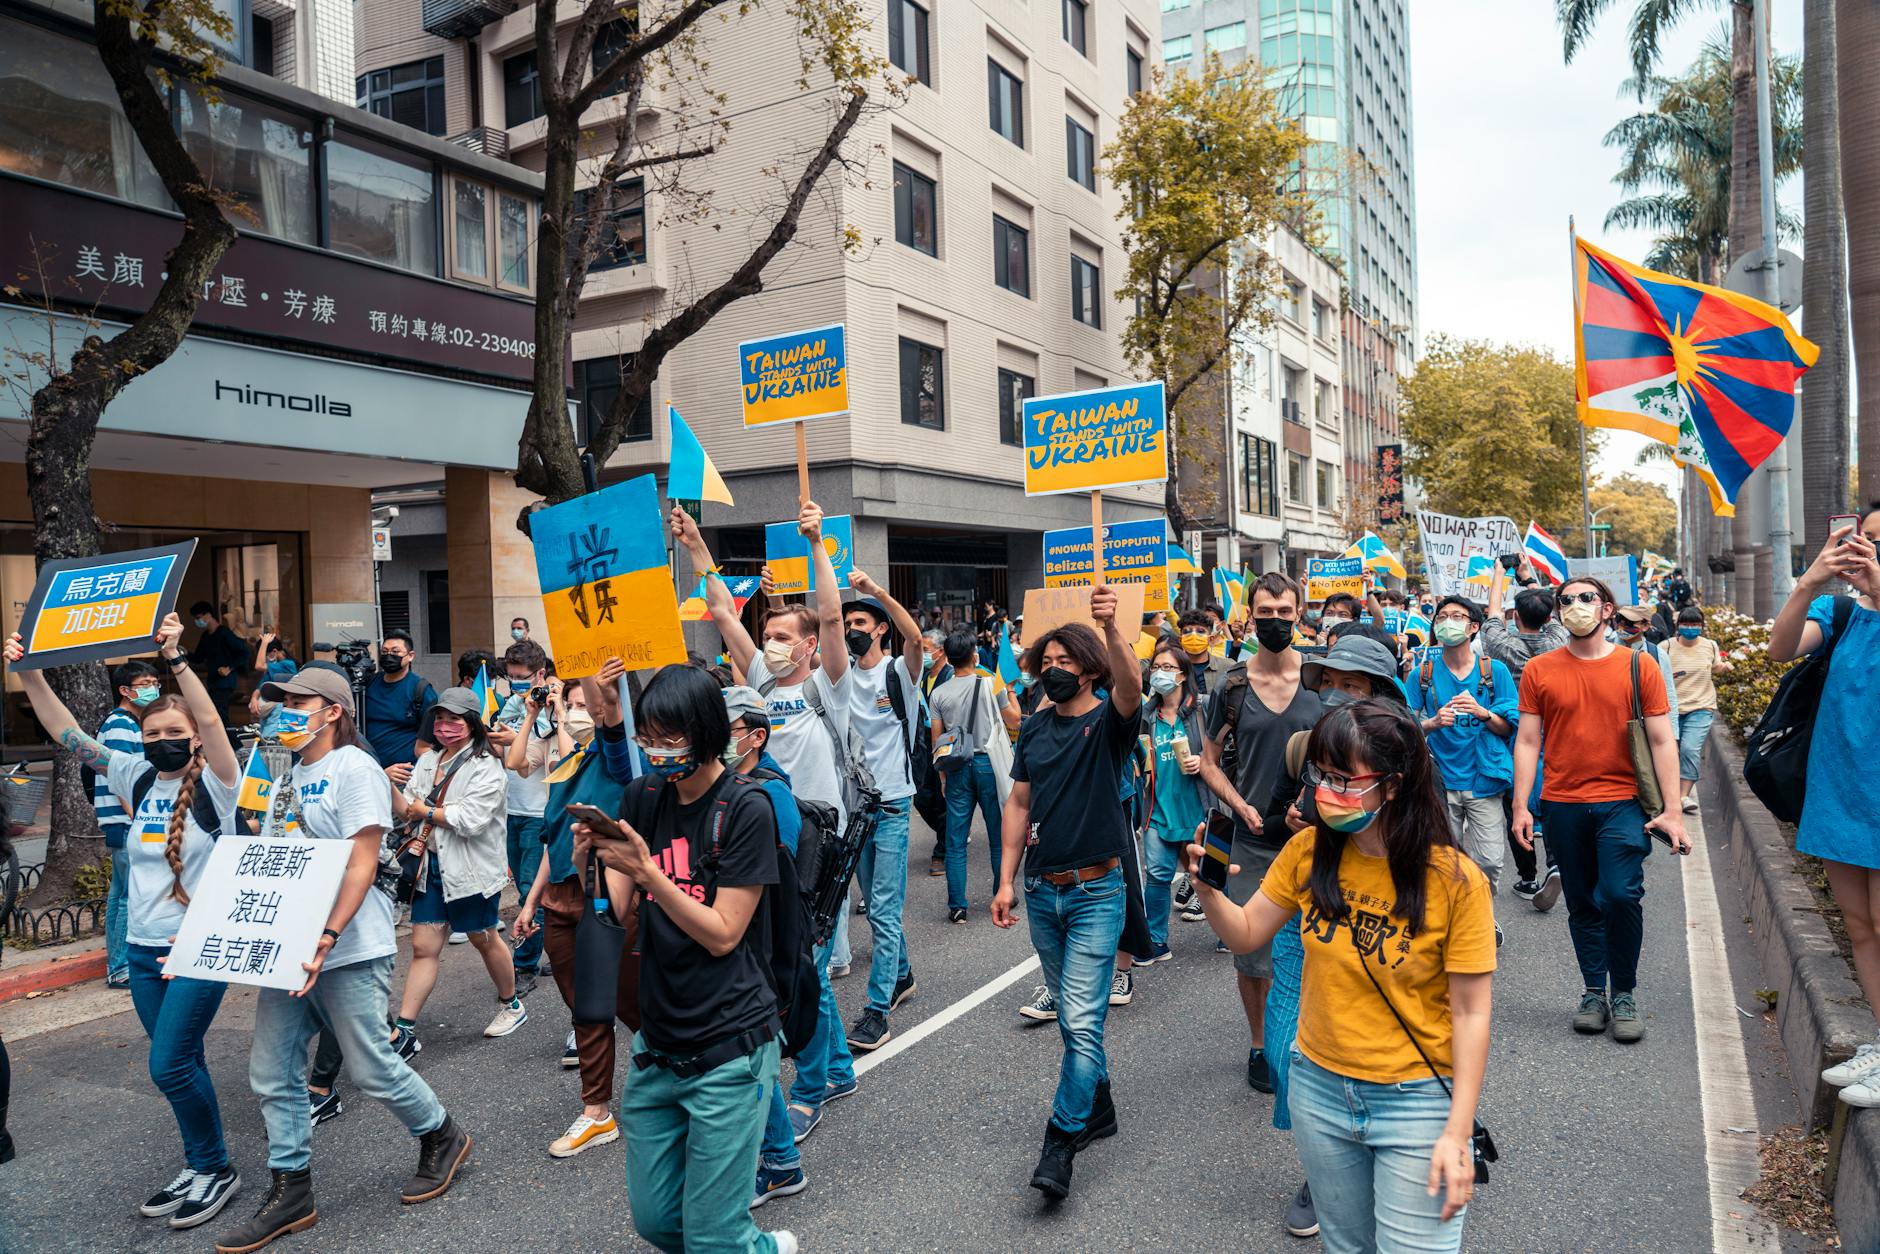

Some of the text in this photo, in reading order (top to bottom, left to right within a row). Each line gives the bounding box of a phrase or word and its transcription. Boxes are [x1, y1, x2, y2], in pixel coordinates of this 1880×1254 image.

[746, 338, 826, 374] TAIWAN
[759, 356, 837, 382] STANDS WITH
[215, 379, 353, 417] himolla
[745, 371, 841, 406] UKRAINE
[1032, 398, 1139, 436] TAIWAN
[1048, 416, 1153, 445] STANDS WITH
[1029, 430, 1158, 470] UKRAINE
[1046, 551, 1154, 574] Belizeas Stand
[1049, 536, 1161, 556] #NOWAR STOPPUTIN
[61, 567, 153, 602] 烏克蘭
[1105, 573, 1151, 584] kraine
[60, 602, 129, 634] 加油!
[235, 843, 315, 880] 俄羅斯
[227, 889, 283, 926] 滾出
[193, 933, 282, 976] 烏克蘭!
